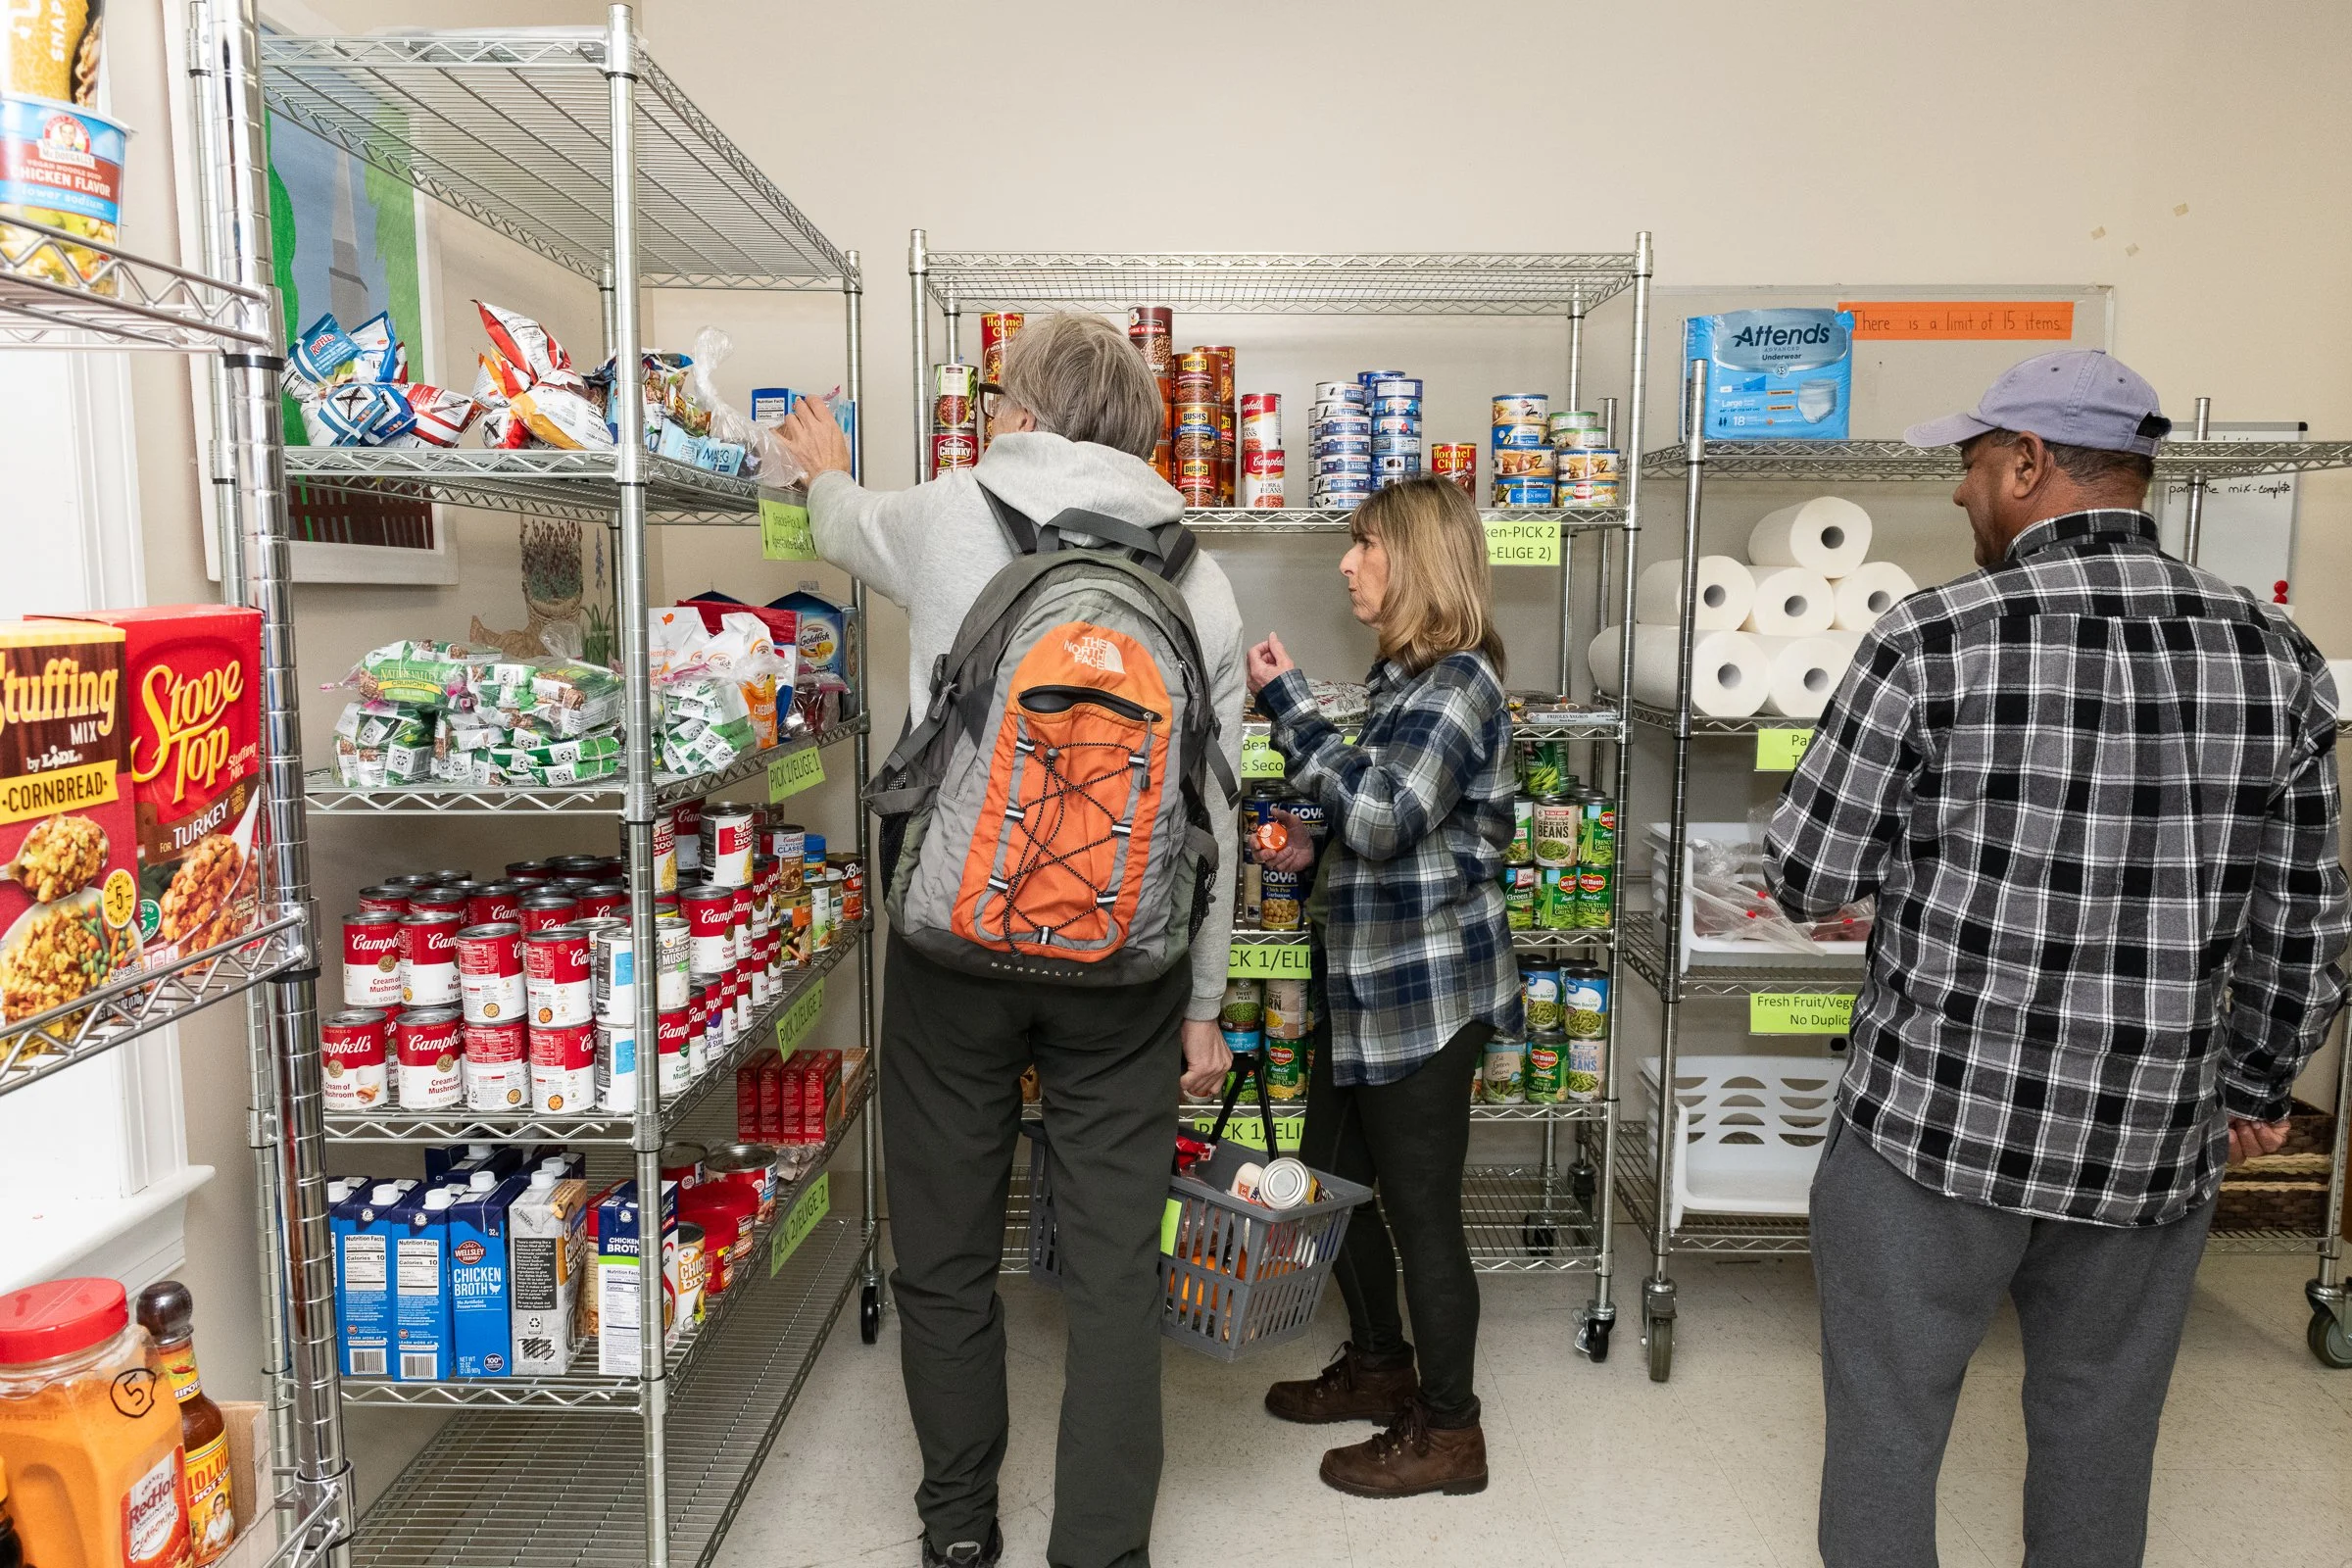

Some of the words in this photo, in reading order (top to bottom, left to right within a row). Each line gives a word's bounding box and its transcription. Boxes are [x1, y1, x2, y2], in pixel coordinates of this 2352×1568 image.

[56, 164, 85, 176] NOODLE
[74, 175, 111, 197] FLAVOR
[23, 183, 61, 200] lower
[64, 194, 105, 211] sodium
[987, 317, 1025, 327] Hormel
[1850, 310, 1890, 331] There
[1909, 314, 1919, 331] is
[1930, 318, 1938, 330] a
[1946, 311, 1974, 331] limit
[1981, 313, 1993, 331] of
[2003, 310, 2016, 330] 15
[1732, 322, 1831, 348] Attends
[311, 334, 335, 356] RUFFLES
[1183, 359, 1206, 368] BUSH'S
[1761, 352, 1802, 361] Underwear
[1722, 399, 1742, 409] Large
[1183, 413, 1206, 421] BUSH'S
[1734, 416, 1745, 426] 18
[1179, 423, 1211, 432] Vegetarian
[939, 446, 971, 458] CHUNKY
[1434, 449, 1471, 459] Hormel
[1185, 466, 1207, 474] BUSH'S
[1437, 459, 1464, 469] Chili
[1181, 476, 1211, 485] Homestyle
[2169, 479, 2219, 505] panke
[1548, 526, 1555, 539] 2
[1539, 546, 1551, 562] 2)
[800, 632, 831, 647] Goldfish
[1082, 636, 1106, 649] THE
[1063, 641, 1106, 662] NORTH
[1073, 654, 1105, 670] FACE
[0, 652, 119, 736] tuffing
[130, 661, 243, 783] Stove
[70, 720, 97, 746] MIX
[1243, 740, 1271, 752] Bea
[227, 742, 257, 770] Stuffing
[26, 757, 40, 773] by
[168, 726, 230, 806] Top
[229, 763, 245, 782] Mix
[770, 764, 787, 791] PICK
[812, 753, 820, 770] 1
[1251, 760, 1284, 771] Seco
[8, 771, 104, 812] CORNBREAD
[1290, 807, 1325, 820] GOYA
[160, 841, 172, 854] FOR
[172, 798, 229, 850] TURKEY
[1538, 826, 1569, 838] BEANS
[106, 874, 122, 893] READY
[123, 877, 130, 887] IN
[1262, 869, 1298, 883] GOYA
[114, 885, 123, 910] 5
[1506, 893, 1529, 902] Green
[108, 906, 133, 925] MINUTES
[1258, 950, 1310, 971] 1/ELI
[990, 961, 1085, 977] BOREALIS
[392, 976, 401, 985] of
[378, 996, 397, 1004] SOUP
[1757, 996, 1790, 1007] Fresh
[1793, 996, 1855, 1010] Fruit/Vege
[779, 1021, 796, 1050] PICK
[817, 989, 823, 1008] 2
[1789, 1014, 1808, 1026] No
[1811, 1014, 1852, 1029] Duplica
[428, 1083, 462, 1095] Mushroom
[431, 1077, 452, 1087] Cream
[1250, 1122, 1303, 1144] 1/ELI
[819, 1184, 825, 1203] 2
[455, 1248, 485, 1257] WELLSLEY
[454, 1267, 502, 1283] CHICKEN
[454, 1282, 488, 1297] BROTH
[122, 1372, 145, 1406] 5
[194, 1481, 216, 1503] HOT
[128, 1472, 177, 1530] RedHot
[135, 1501, 169, 1532] ORIGINAL
[129, 1505, 178, 1562] Seasoning
